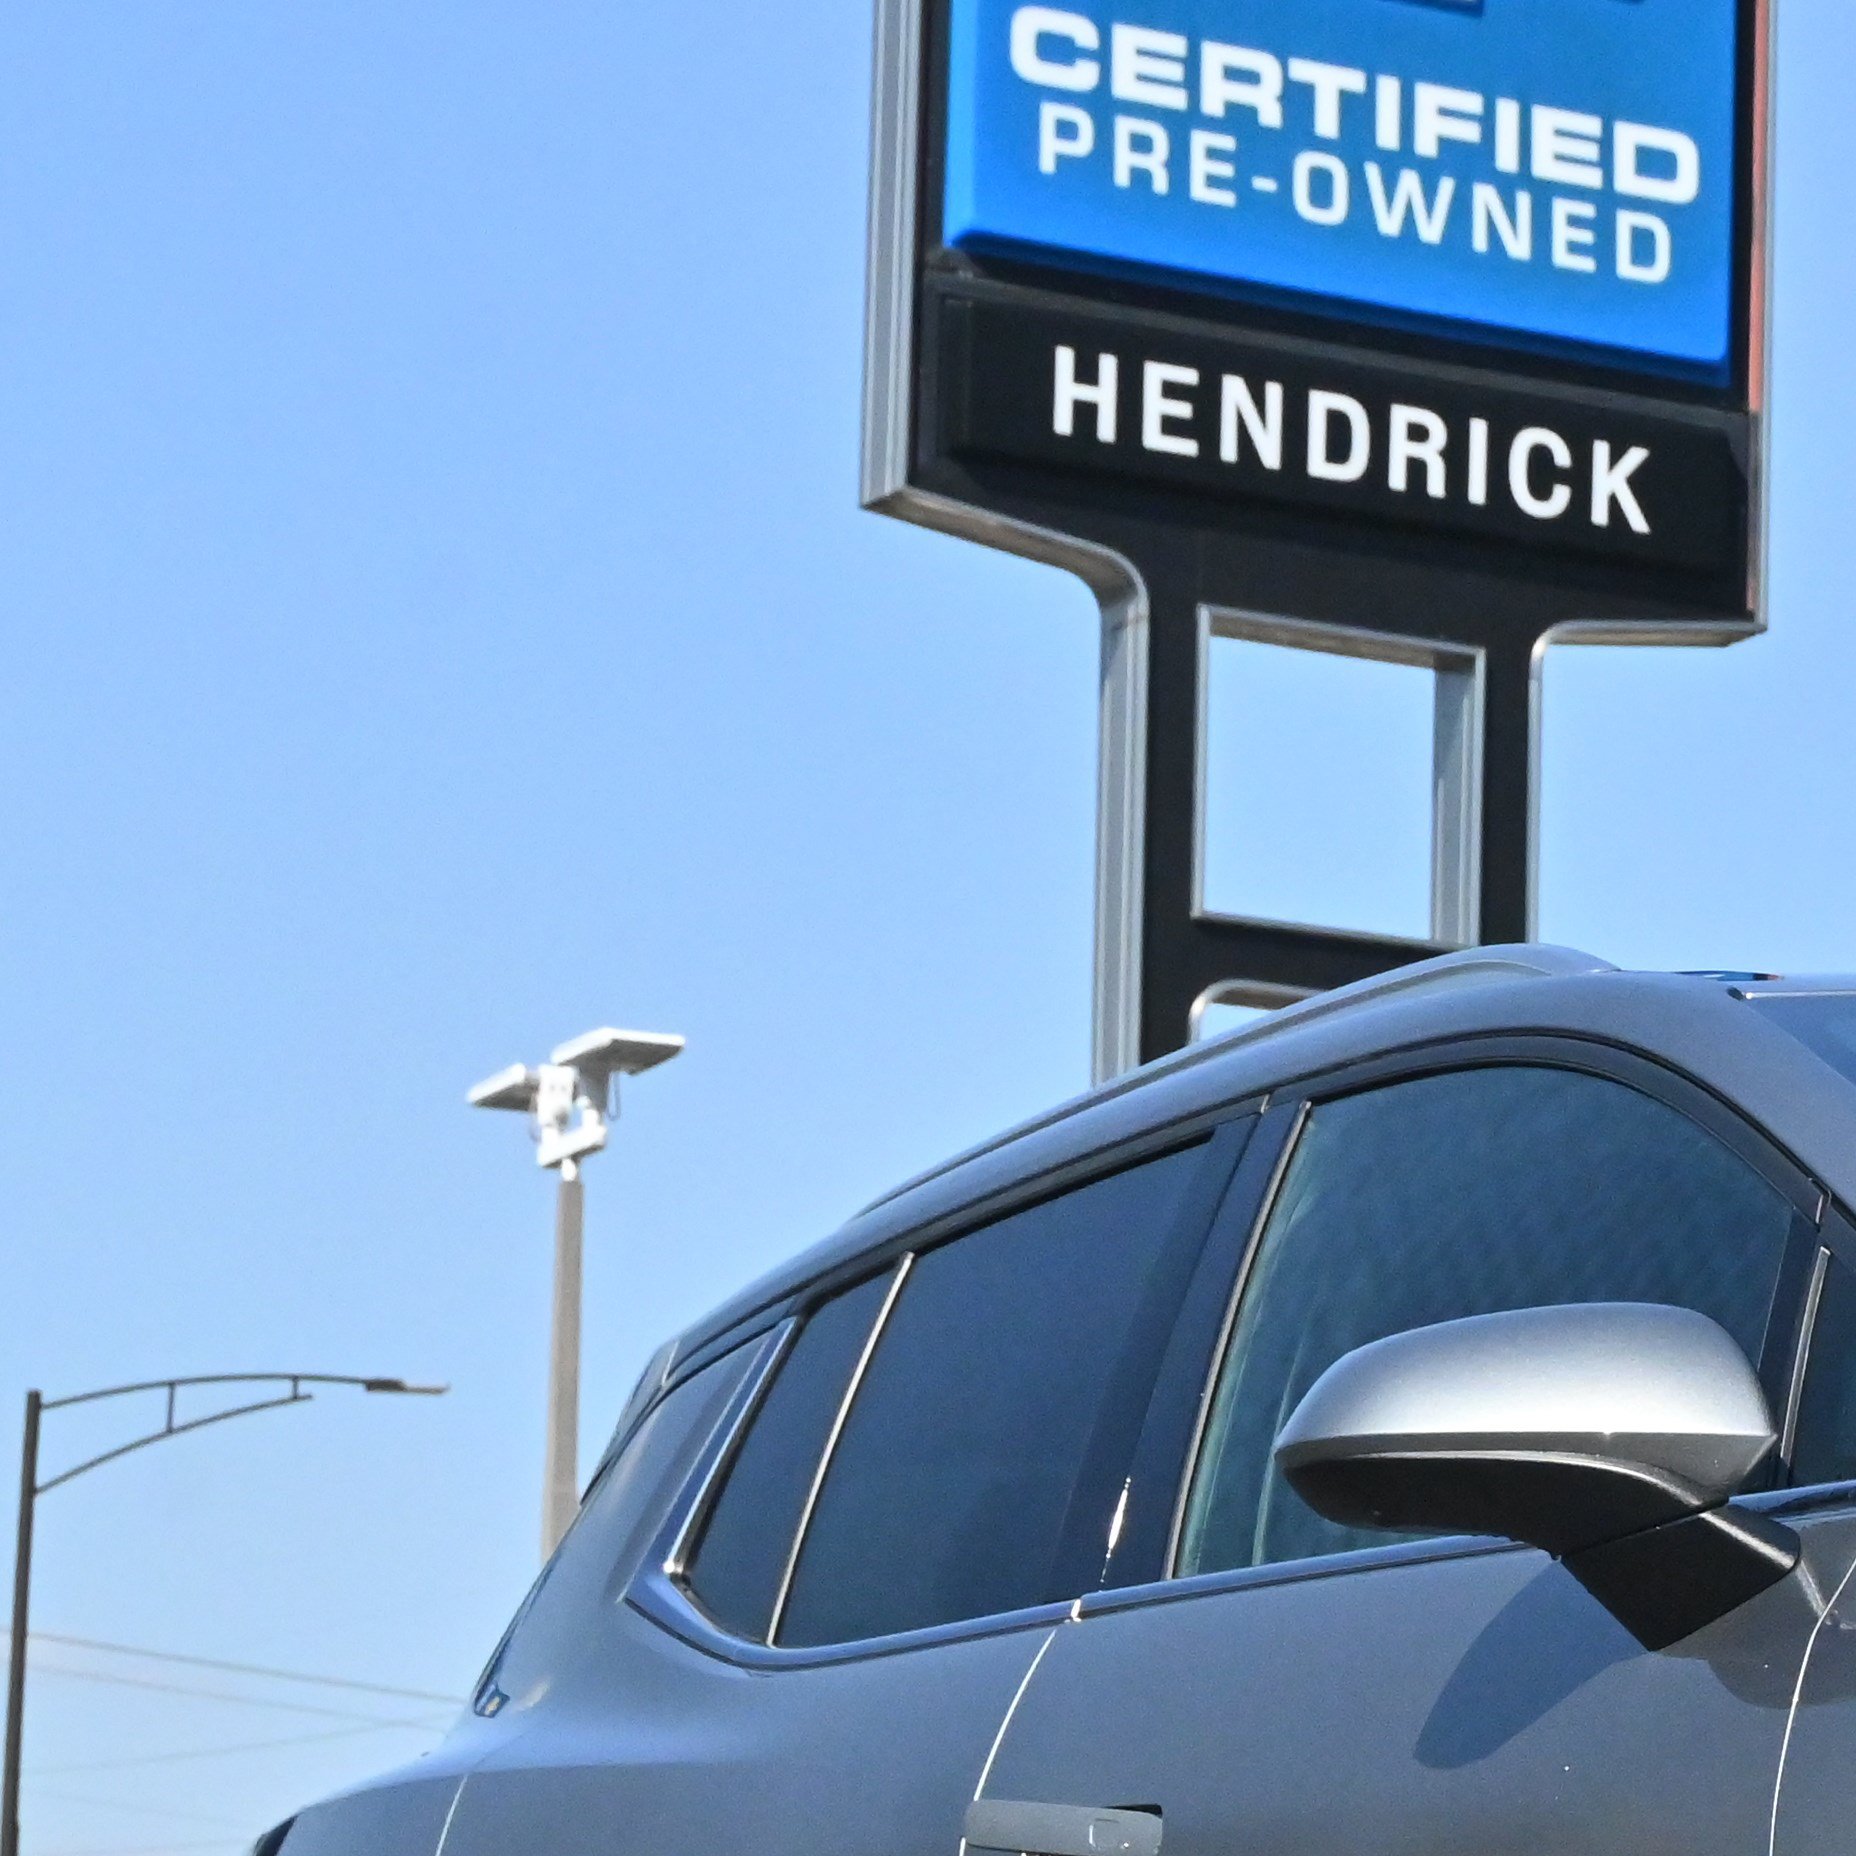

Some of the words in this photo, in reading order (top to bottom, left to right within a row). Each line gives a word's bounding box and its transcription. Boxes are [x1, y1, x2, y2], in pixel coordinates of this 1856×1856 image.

[1009, 6, 1700, 205] CERTIFIED
[1037, 102, 1672, 284] PRE-OWNED
[1052, 345, 1651, 534] HENDRICK
